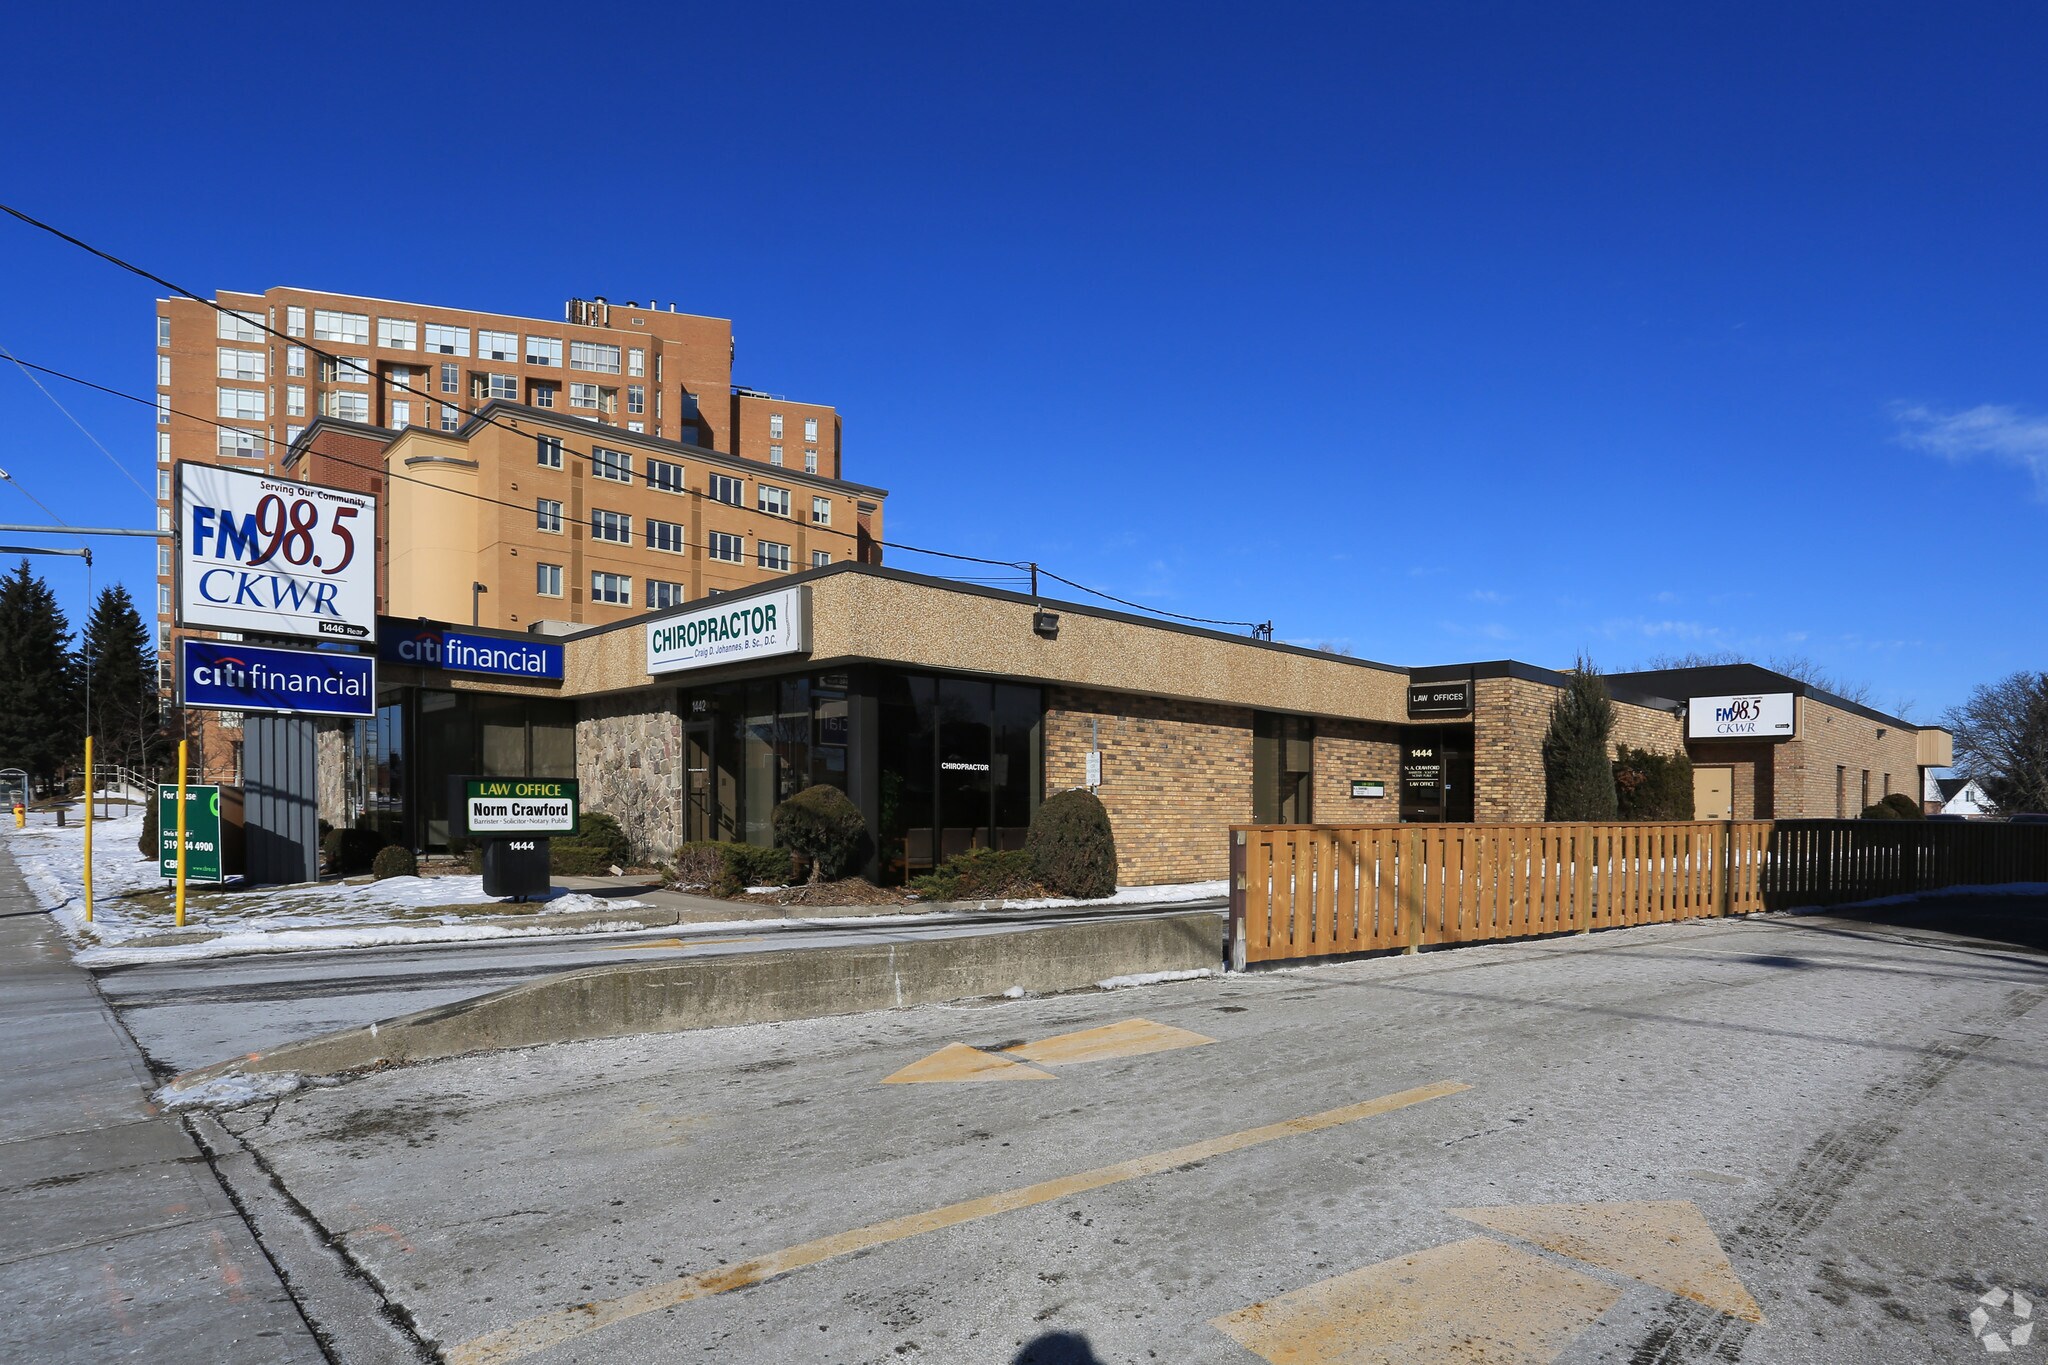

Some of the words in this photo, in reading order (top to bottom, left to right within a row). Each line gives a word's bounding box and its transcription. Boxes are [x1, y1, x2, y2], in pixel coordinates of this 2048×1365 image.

[260, 481, 294, 496] Serving
[297, 487, 315, 497] Our
[317, 491, 366, 508] Community
[199, 568, 342, 616] CKWR
[321, 623, 345, 634] 1446
[346, 627, 364, 635] Rear
[652, 604, 777, 653] CHIROPRACTOR
[694, 646, 708, 659] Craig
[709, 646, 715, 656] D.
[715, 643, 742, 655] Johannes,
[744, 640, 751, 649] B.
[764, 635, 777, 645] D.C.
[692, 700, 706, 712] 1442
[1717, 722, 1756, 733] CKWR
[942, 762, 989, 771] CHIROPRACTOR
[480, 783, 511, 795] LAW
[515, 783, 562, 796] OFFICE
[163, 791, 174, 800] For
[176, 791, 196, 801] Lase
[474, 803, 507, 816] Norm
[511, 802, 568, 816] Crawford
[164, 840, 177, 850] 519
[194, 841, 213, 852] 4900
[509, 842, 534, 850] 1444
